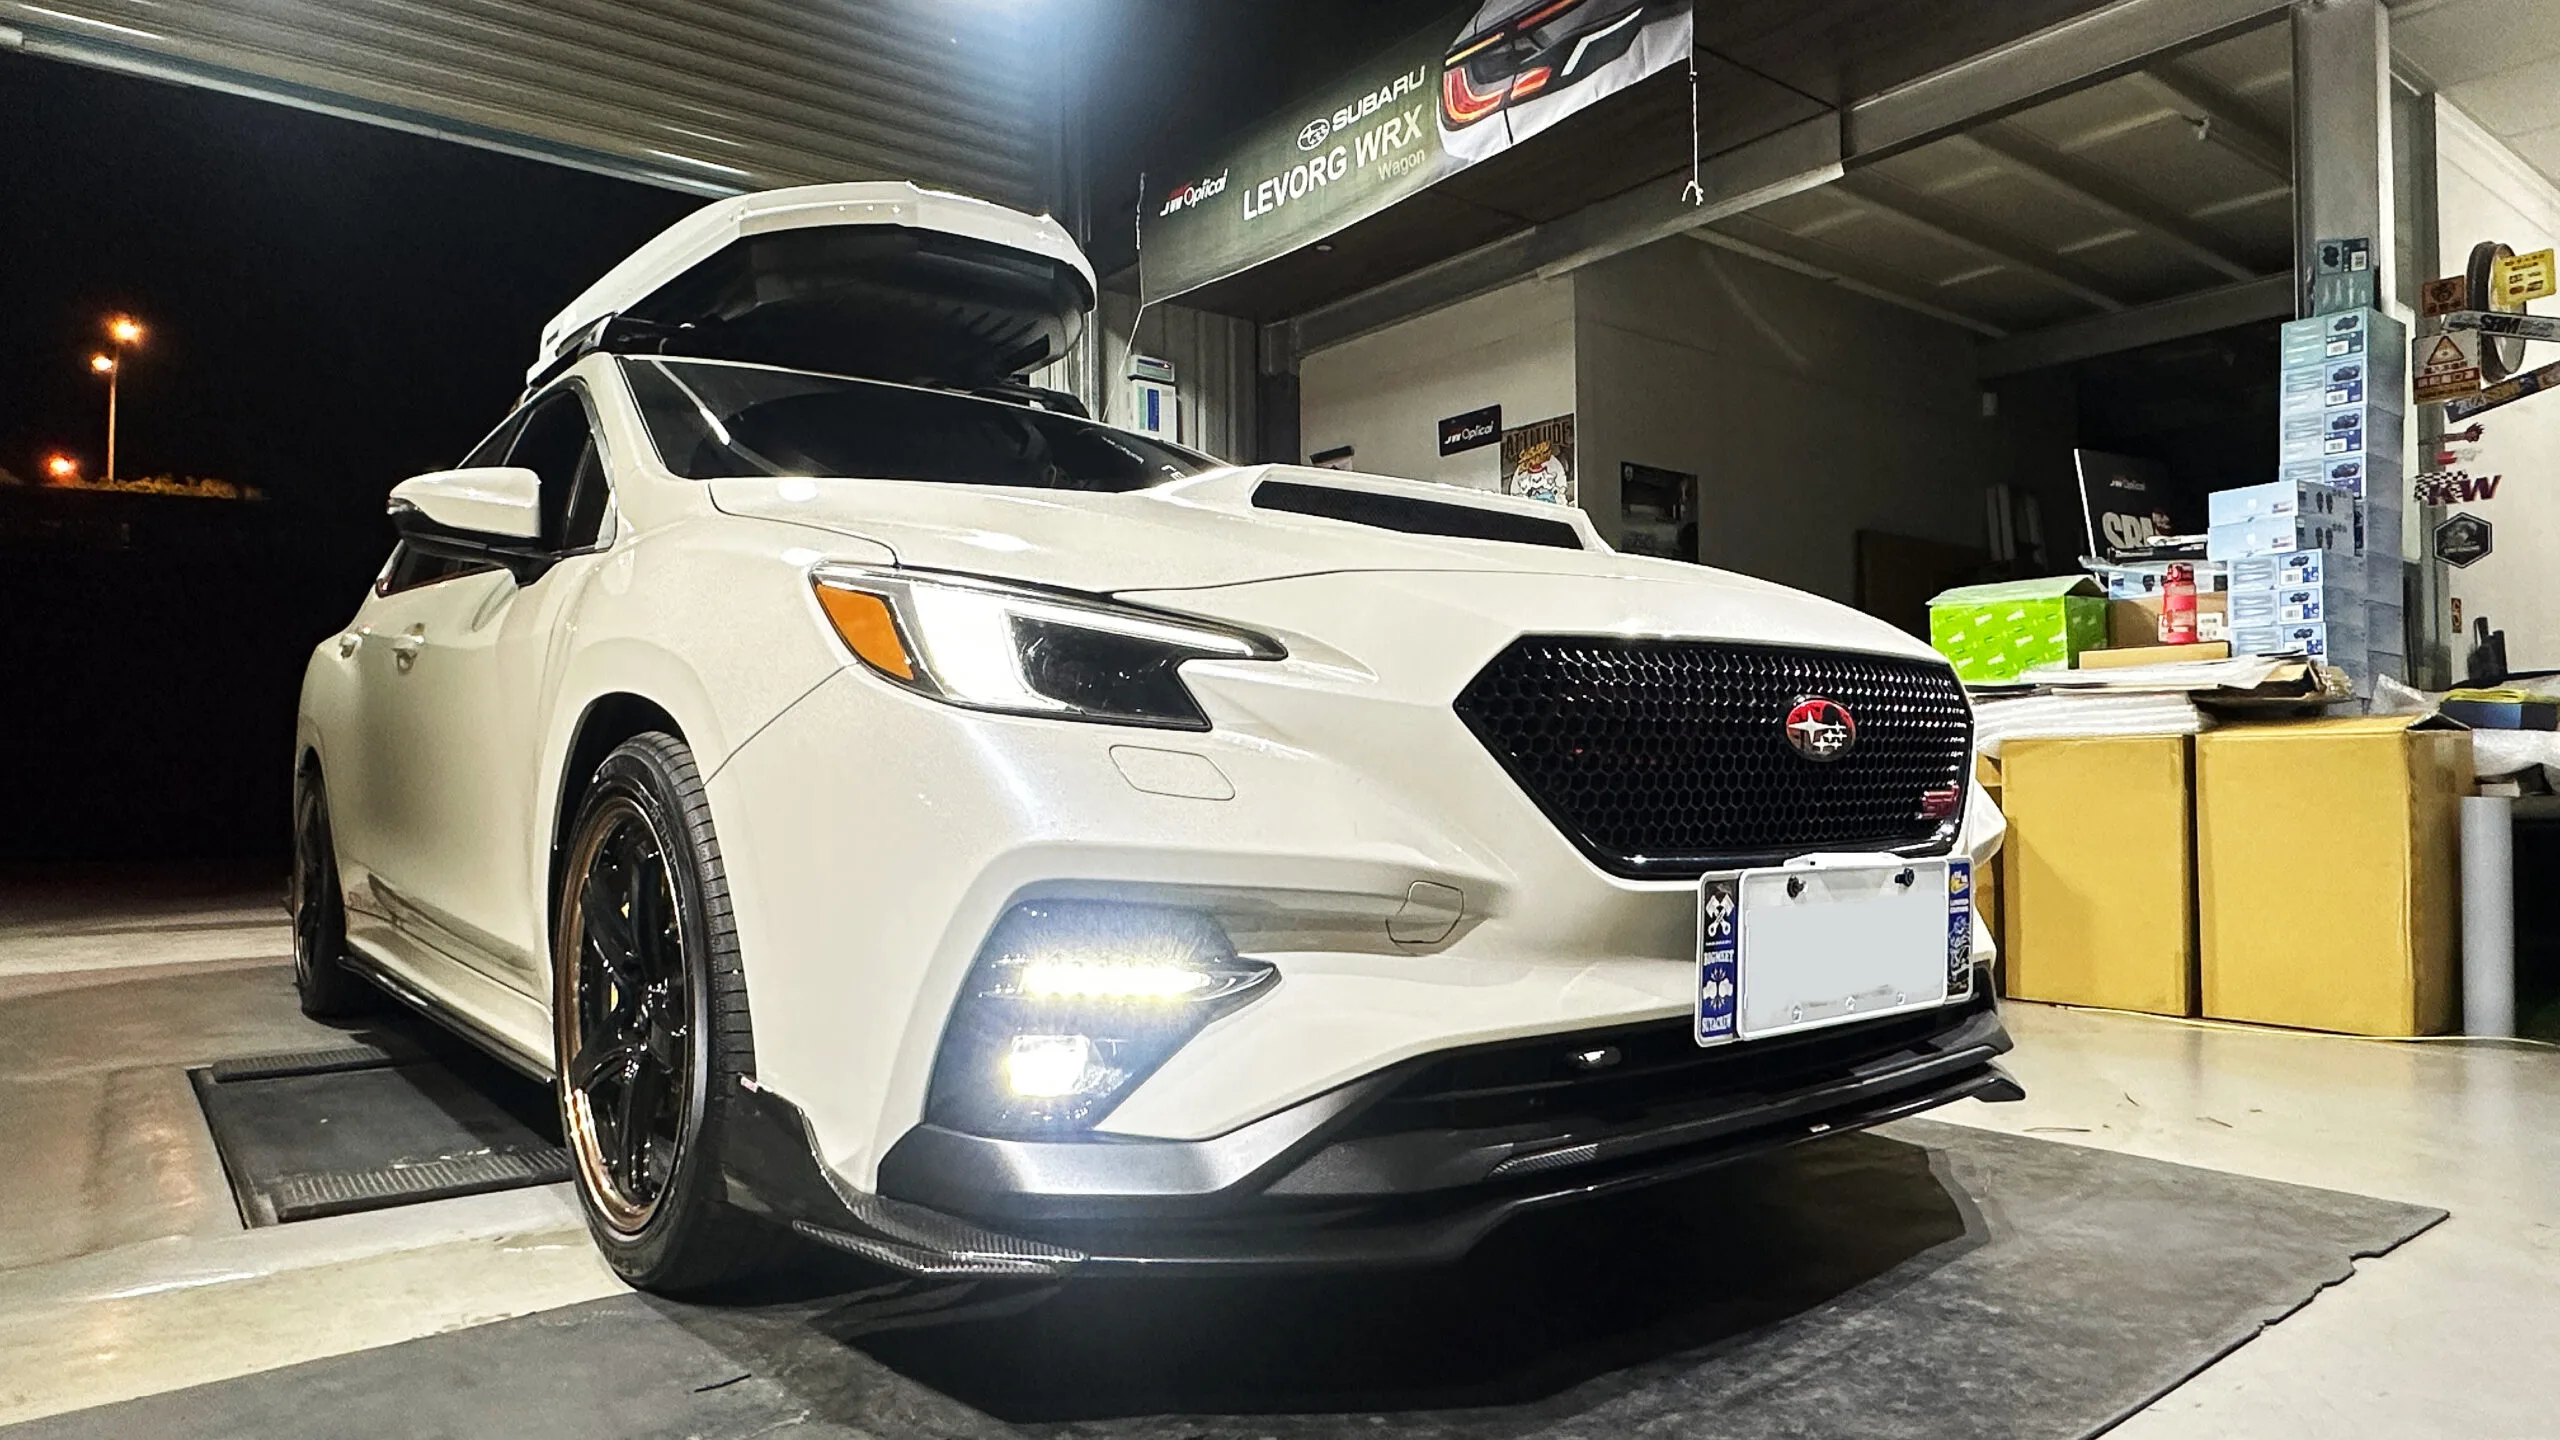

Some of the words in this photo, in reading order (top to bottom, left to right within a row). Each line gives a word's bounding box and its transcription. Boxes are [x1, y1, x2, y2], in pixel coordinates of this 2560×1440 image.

[1332, 65, 1426, 132] SUBARU
[1243, 145, 1347, 221] LEVORG
[1354, 104, 1423, 169] WRX
[1378, 148, 1426, 181] Wagon
